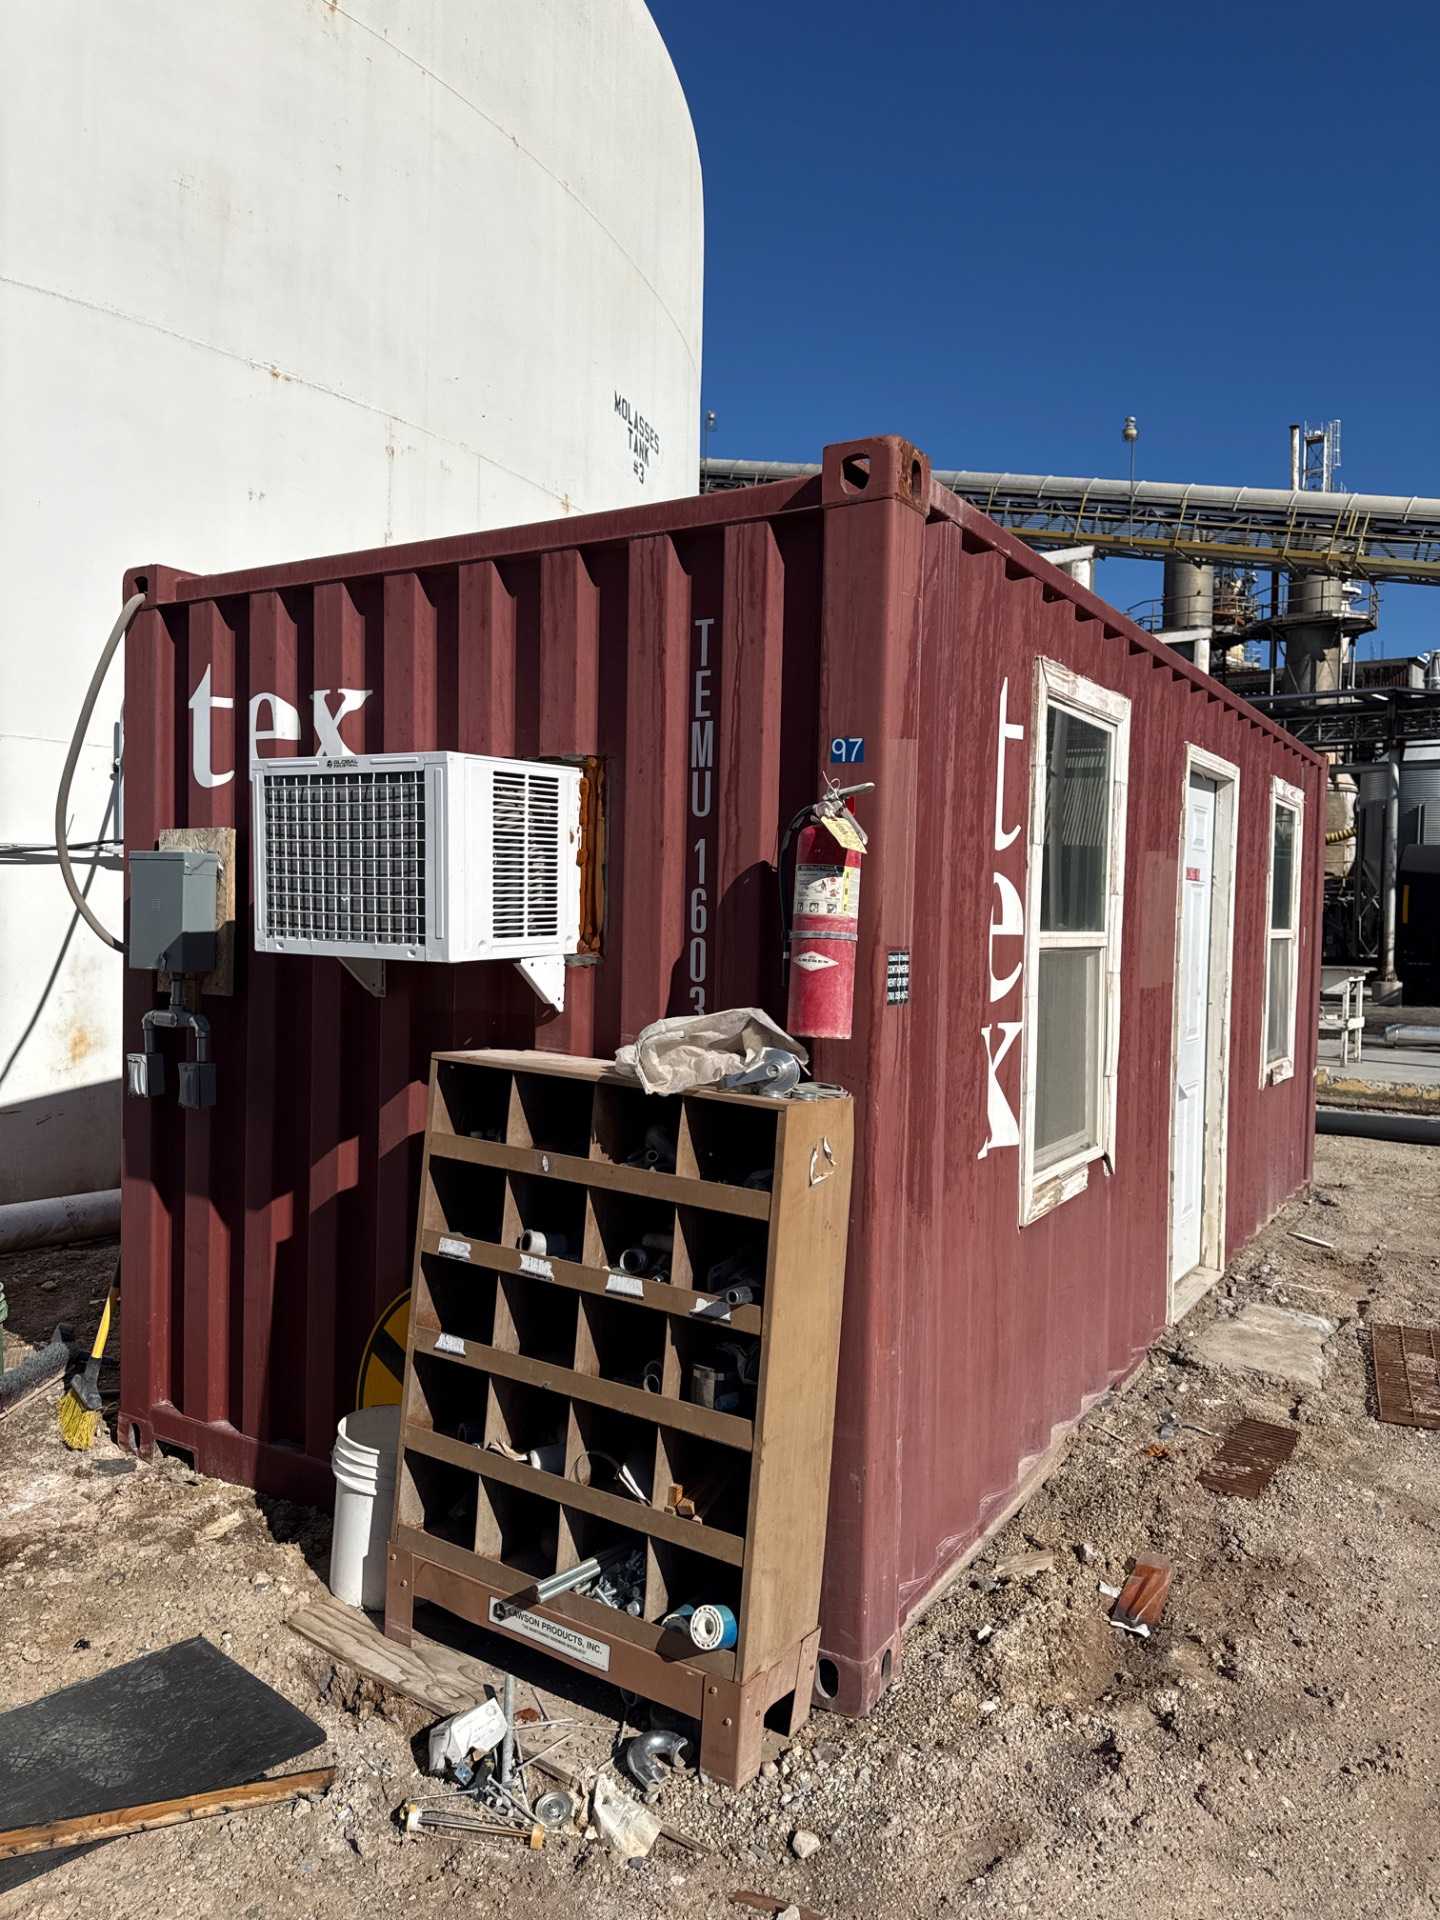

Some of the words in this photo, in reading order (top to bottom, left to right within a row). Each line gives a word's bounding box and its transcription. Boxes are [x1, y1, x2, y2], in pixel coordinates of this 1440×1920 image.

[614, 390, 660, 455] MOLASSES
[627, 427, 650, 467] TANK
[633, 461, 645, 485] #3
[188, 663, 373, 788] tex
[691, 617, 715, 817] TEMU
[832, 738, 863, 762] 97
[541, 1622, 585, 1649] PRODUCTS,
[586, 1641, 602, 1655] INC.
